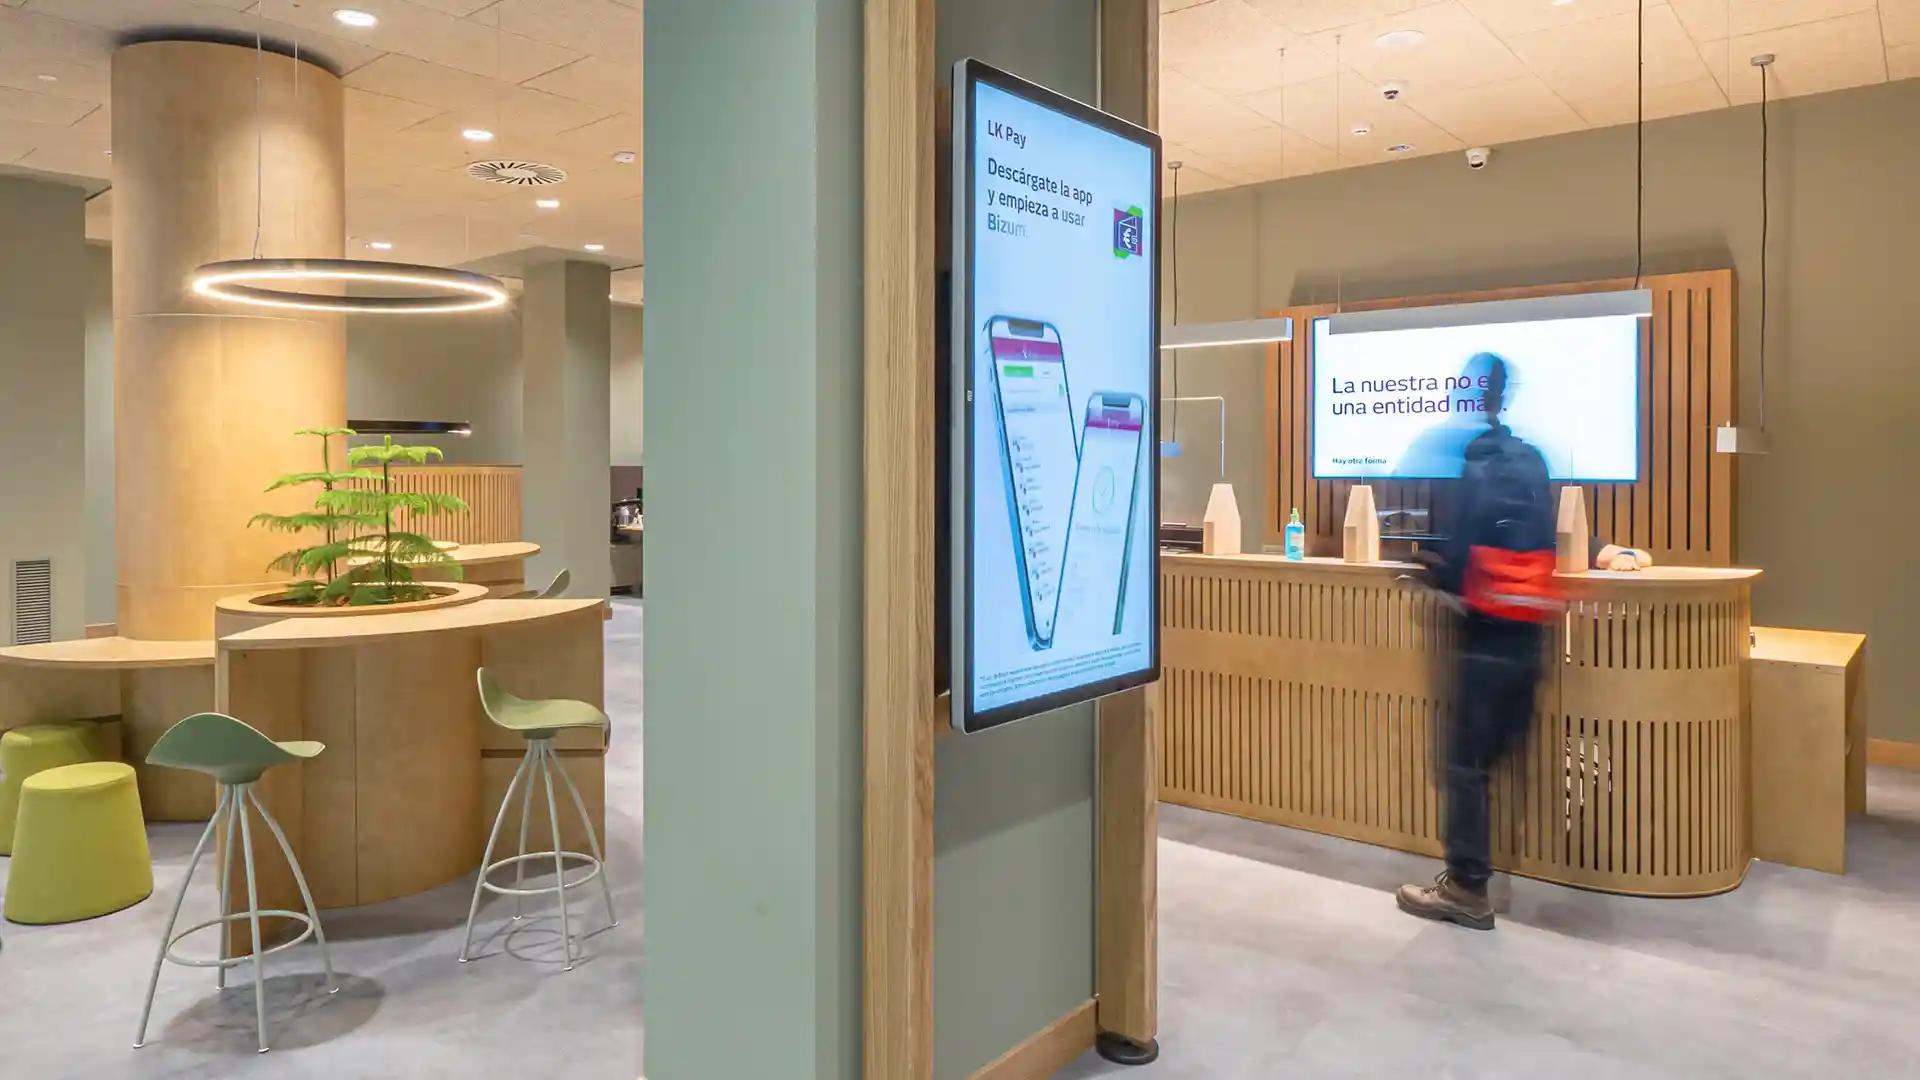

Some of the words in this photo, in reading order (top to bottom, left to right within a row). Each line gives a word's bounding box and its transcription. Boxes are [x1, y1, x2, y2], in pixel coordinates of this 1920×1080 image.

[988, 120, 1003, 139] LK
[1006, 126, 1027, 149] Pay
[988, 157, 1058, 193] Descárgate
[1060, 179, 1070, 197] la
[1073, 187, 1093, 206] app
[987, 189, 996, 206] y
[999, 192, 1049, 217] empieza
[1052, 207, 1059, 220] a
[1062, 210, 1086, 226] usar
[1332, 377, 1355, 394] La
[1361, 376, 1438, 393] nuestra
[1445, 375, 1471, 390] no
[1332, 401, 1367, 415] una
[1373, 395, 1450, 414] entidad
[1332, 457, 1347, 466] Hay
[1347, 457, 1363, 465] otra
[1365, 456, 1387, 465] forma
